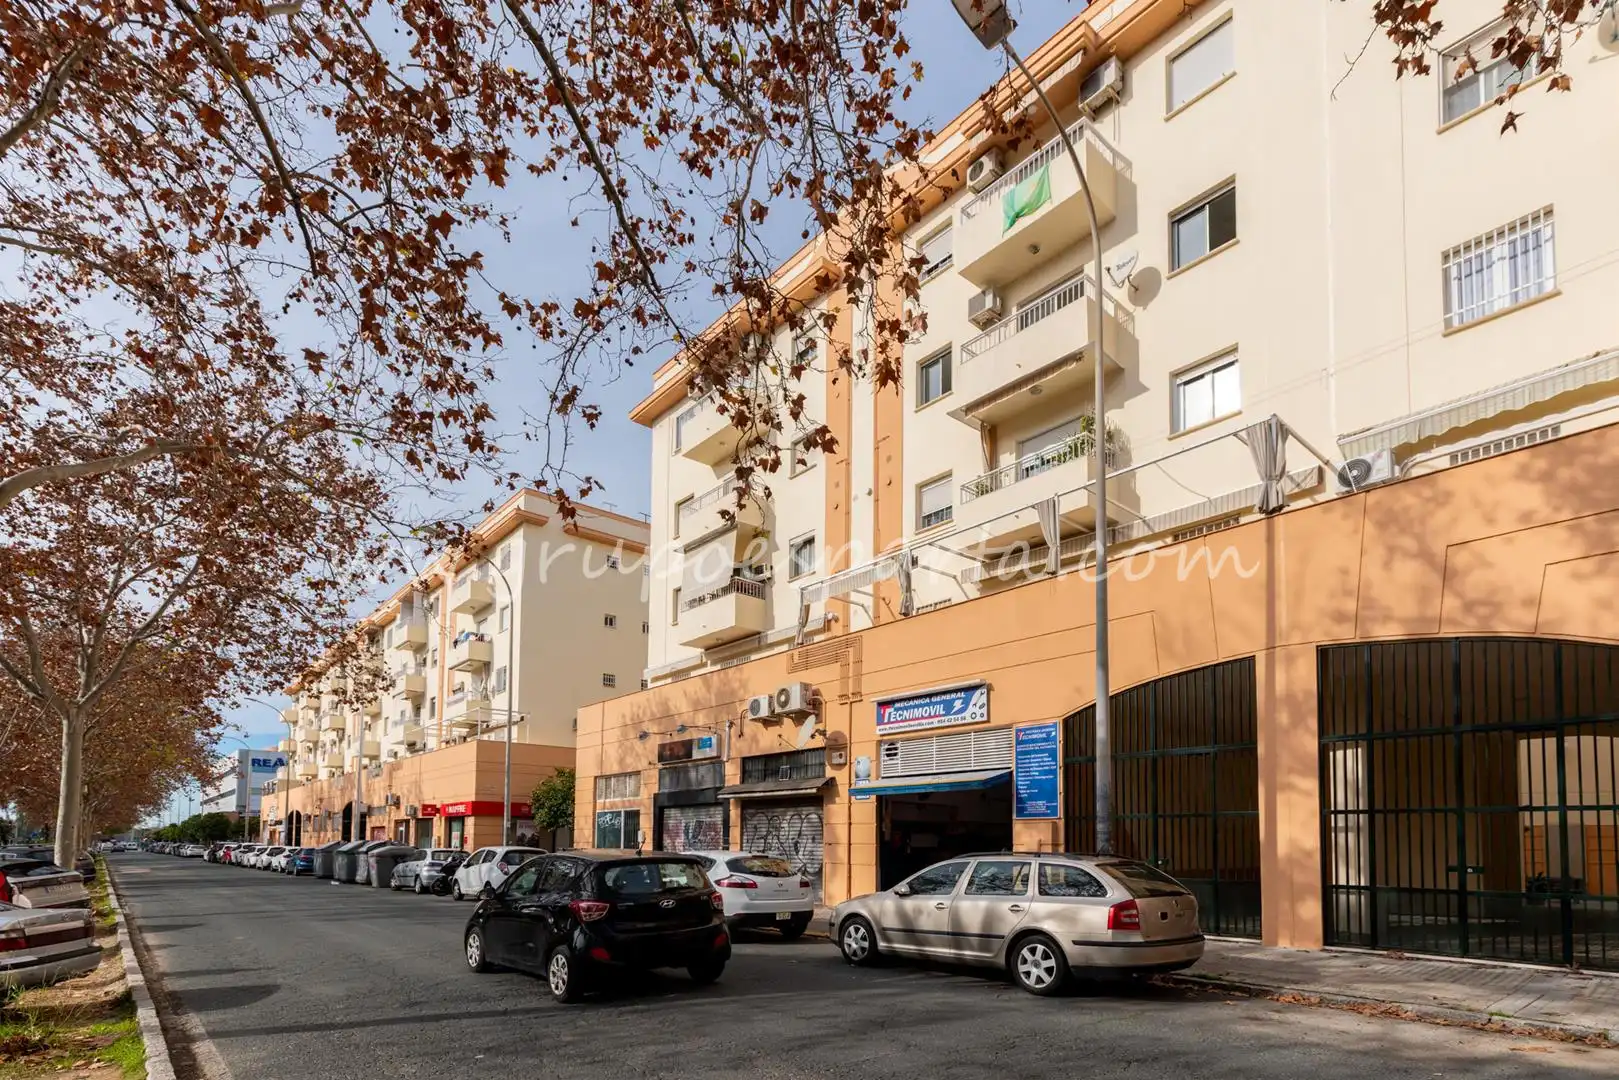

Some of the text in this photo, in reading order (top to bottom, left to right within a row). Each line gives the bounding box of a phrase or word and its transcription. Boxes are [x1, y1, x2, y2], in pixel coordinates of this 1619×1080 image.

[931, 691, 966, 702] GENERAL
[881, 704, 946, 722] TECNIMOVIL
[252, 757, 288, 768] REA
